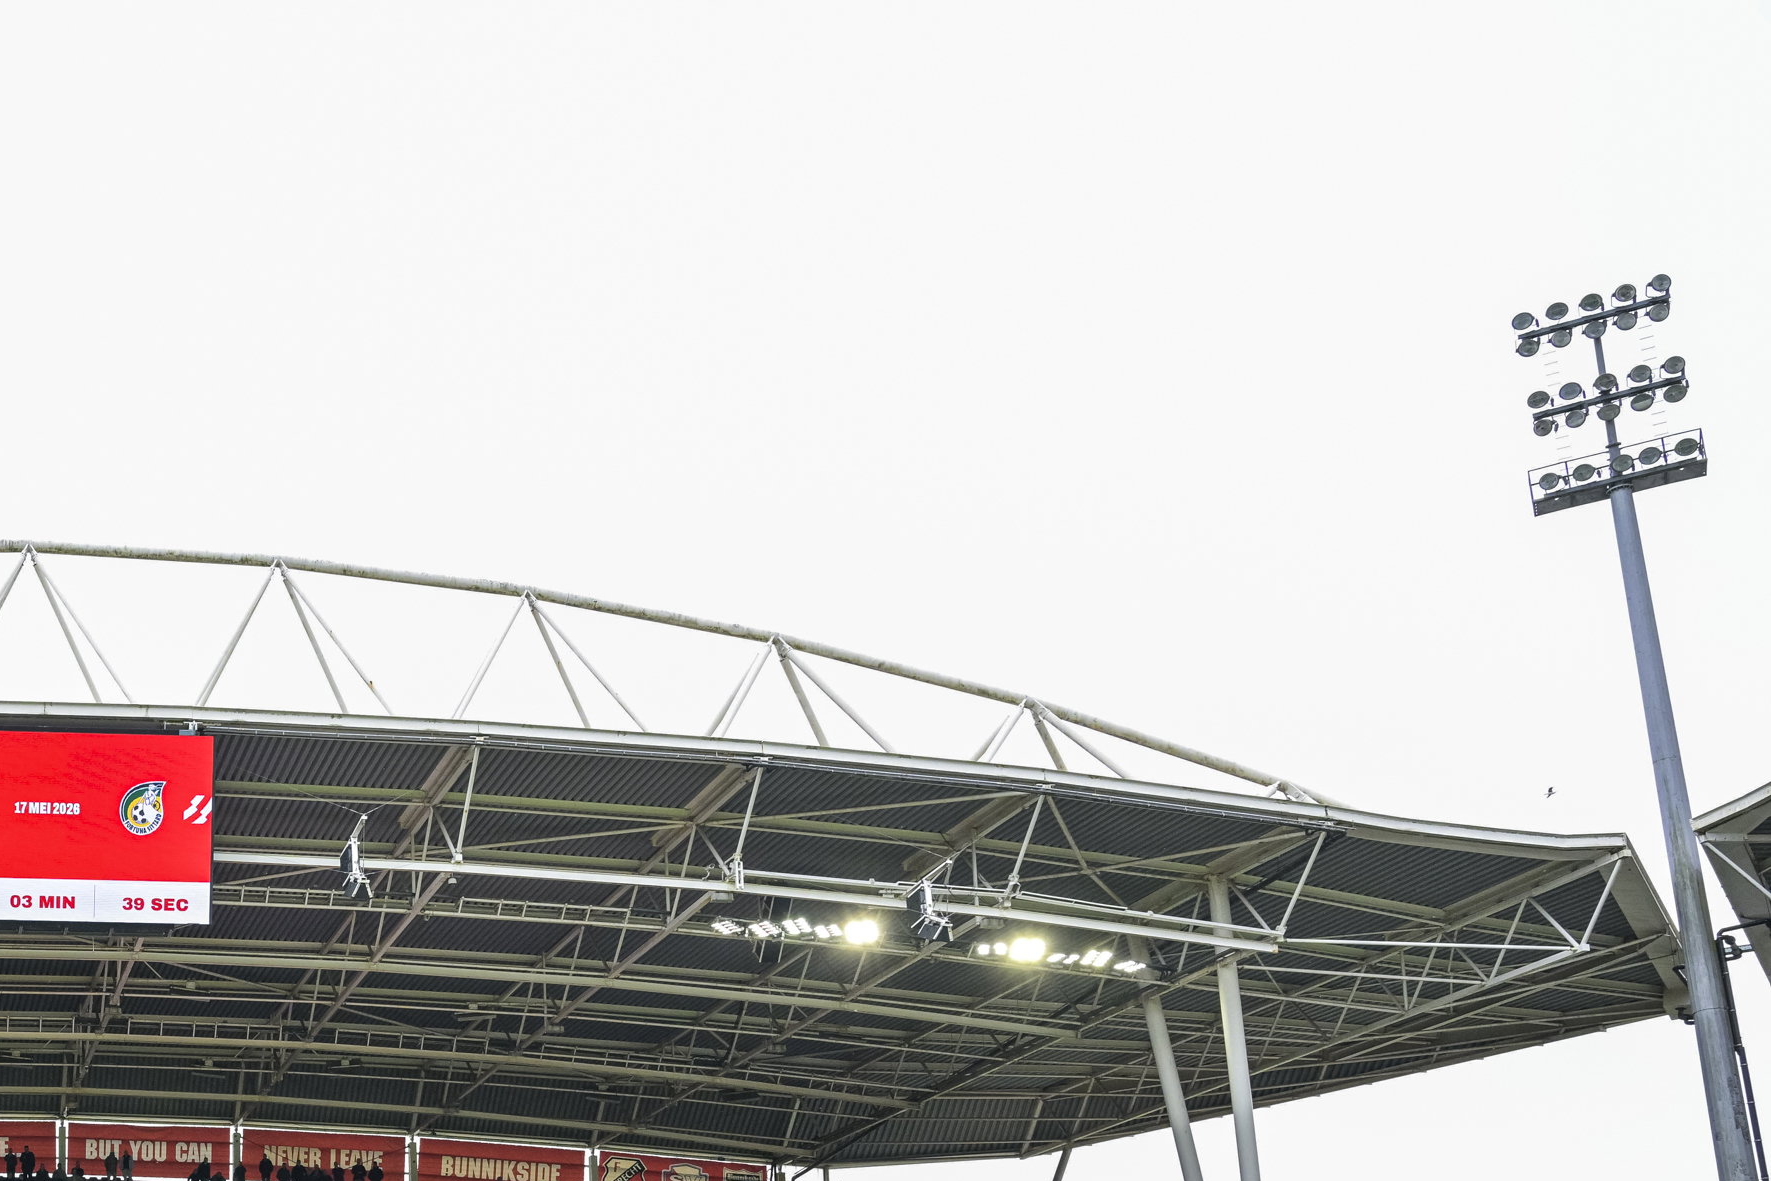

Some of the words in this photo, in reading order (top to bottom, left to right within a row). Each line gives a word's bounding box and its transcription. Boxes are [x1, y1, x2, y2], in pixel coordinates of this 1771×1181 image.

[14, 801, 28, 815] 17
[29, 801, 52, 815] MEI
[53, 802, 80, 815] 2026
[125, 820, 148, 834] FORTUNA
[10, 895, 33, 909] 03
[39, 895, 76, 909] MIN
[122, 897, 143, 911] 39
[151, 898, 189, 912] SEC
[86, 1138, 122, 1160] BUT
[129, 1140, 167, 1162] YOU
[176, 1142, 213, 1163] CAN
[263, 1144, 322, 1168] NEVER
[330, 1149, 384, 1171] LEAVE
